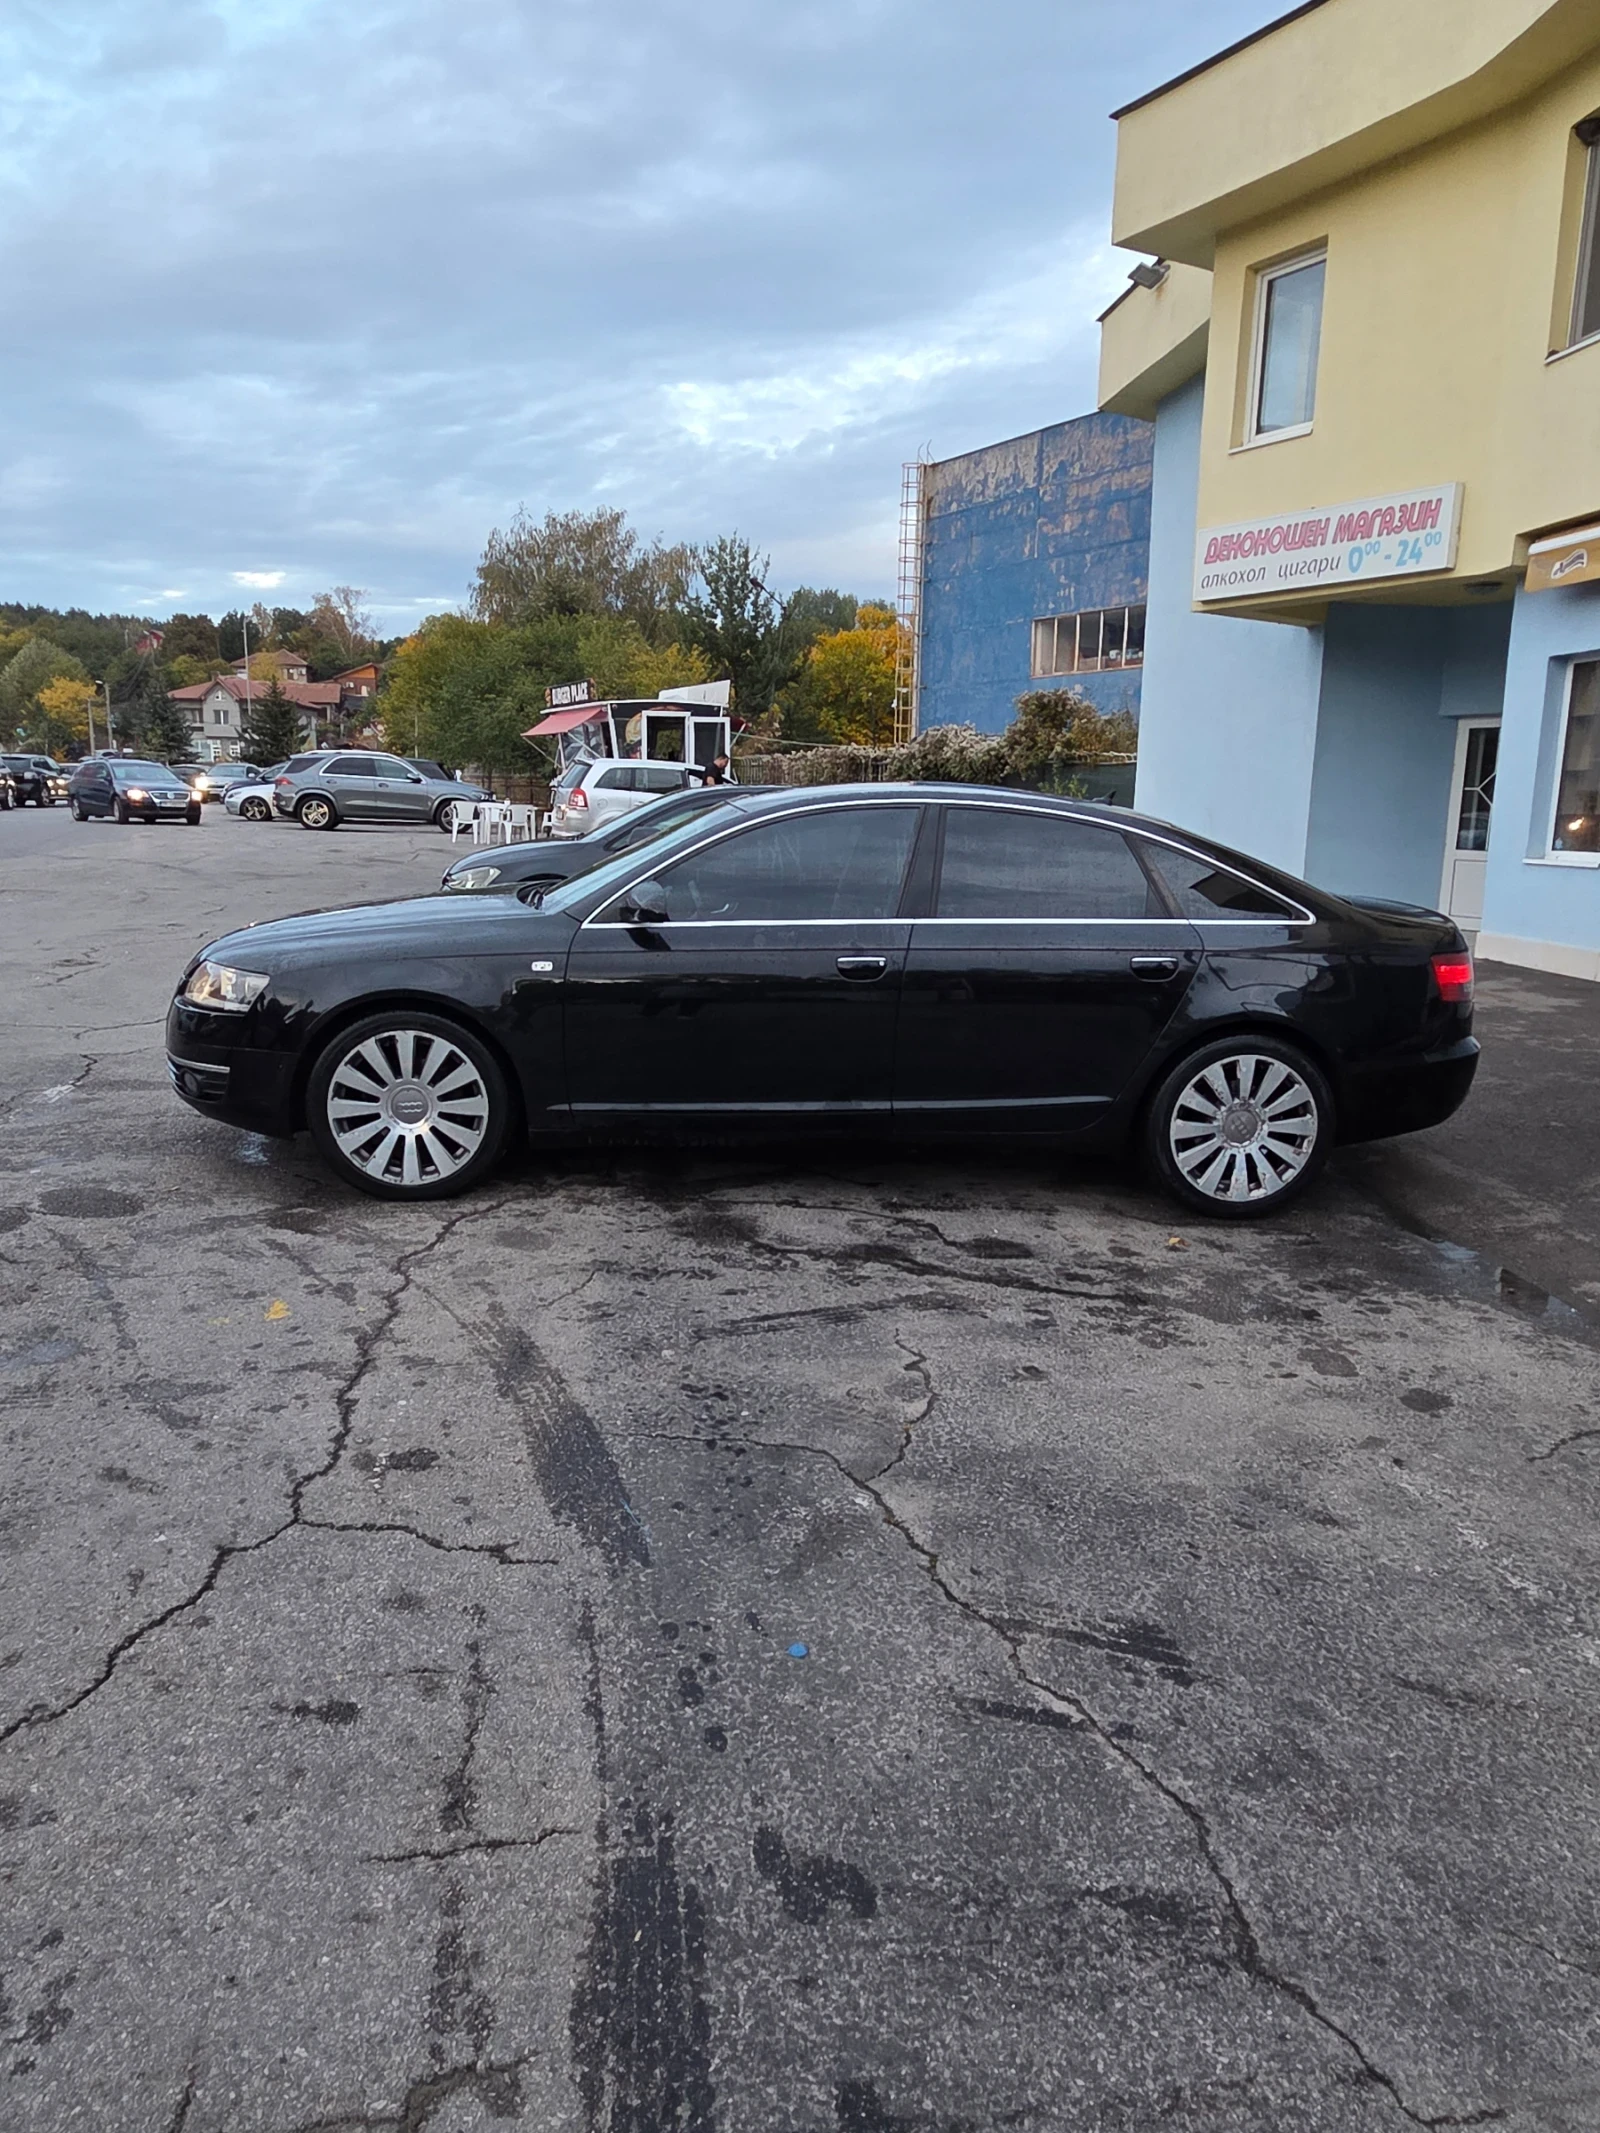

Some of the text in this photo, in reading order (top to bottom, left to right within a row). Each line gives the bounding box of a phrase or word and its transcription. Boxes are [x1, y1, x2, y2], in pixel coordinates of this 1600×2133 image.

[1332, 498, 1443, 545] МАГАЗИН
[1200, 566, 1266, 589] алкохол
[1278, 556, 1341, 581] цигари
